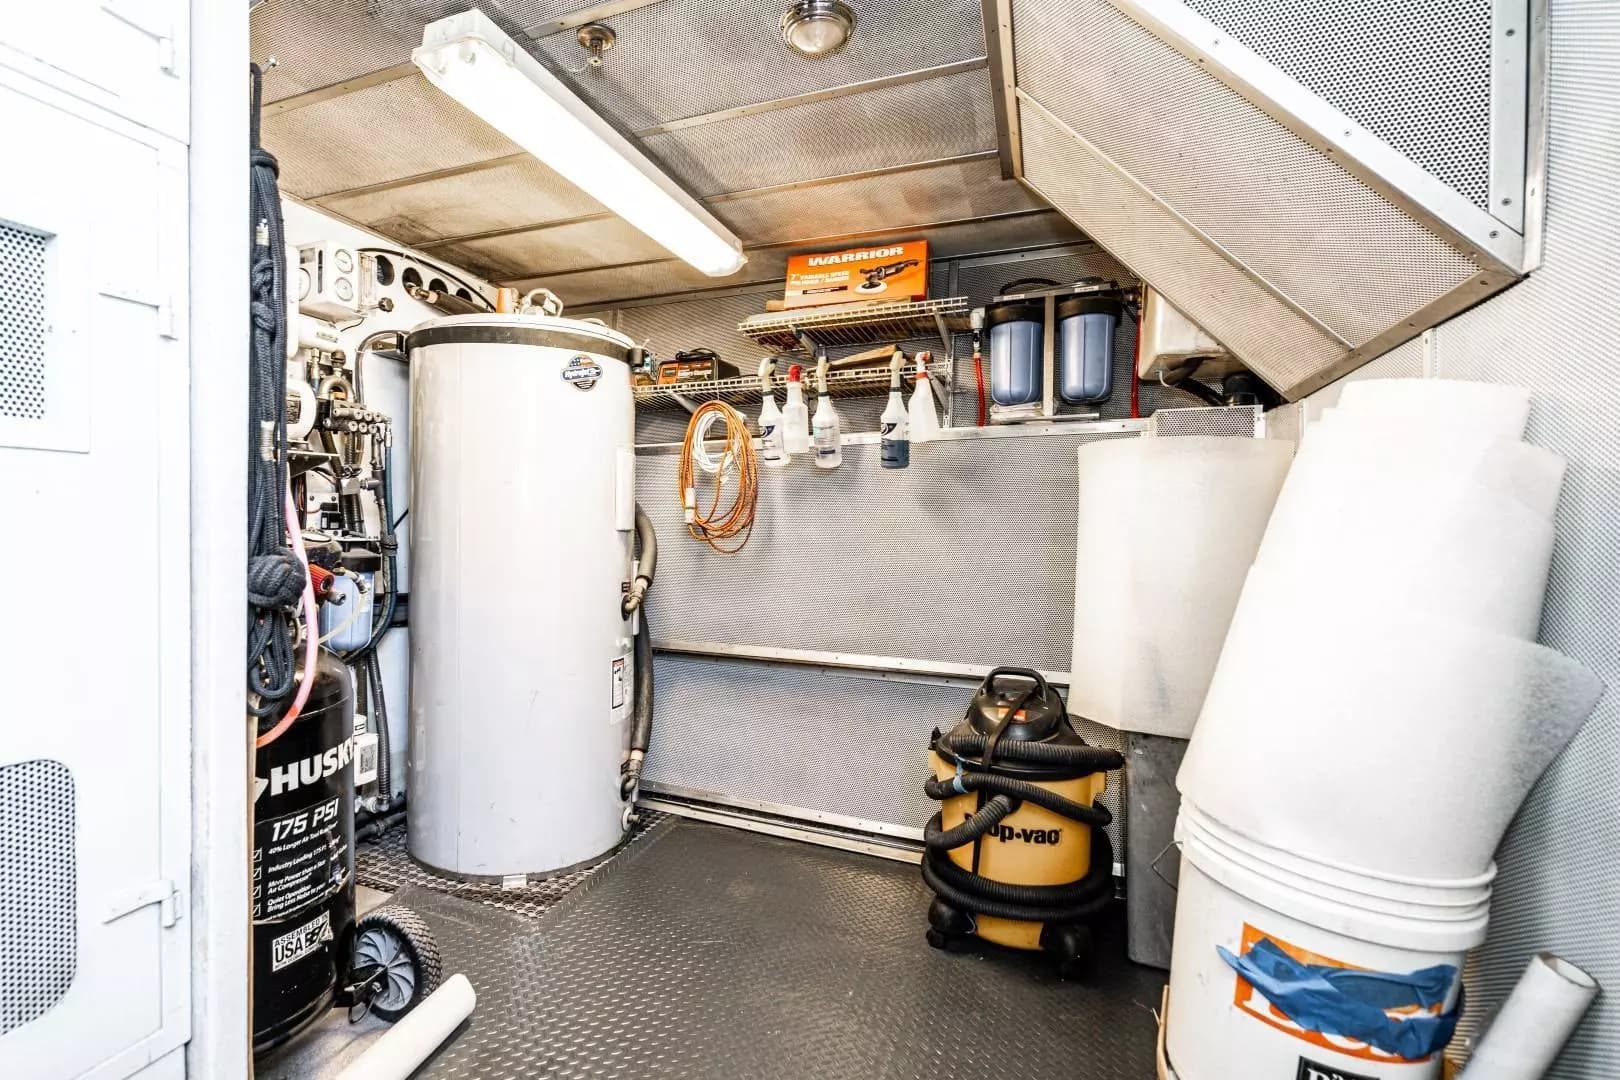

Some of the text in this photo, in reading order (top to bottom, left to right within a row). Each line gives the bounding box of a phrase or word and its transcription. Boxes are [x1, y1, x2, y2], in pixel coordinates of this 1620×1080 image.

[808, 247, 904, 267] WARRIOR
[272, 797, 340, 842] 175 PSI
[268, 845, 282, 854] 40%
[283, 840, 302, 851] Longer
[302, 836, 310, 844] Air
[268, 861, 292, 873] Industry
[293, 852, 313, 865] Leading
[284, 871, 302, 882] Power
[267, 887, 277, 895] Air
[267, 895, 284, 906] Quiet
[284, 884, 312, 901] Operation
[267, 902, 284, 913] Bring
[284, 896, 296, 907] Less
[296, 890, 311, 903] Noise
[275, 918, 320, 947] ASSEMBLED
[275, 936, 304, 963] USA
